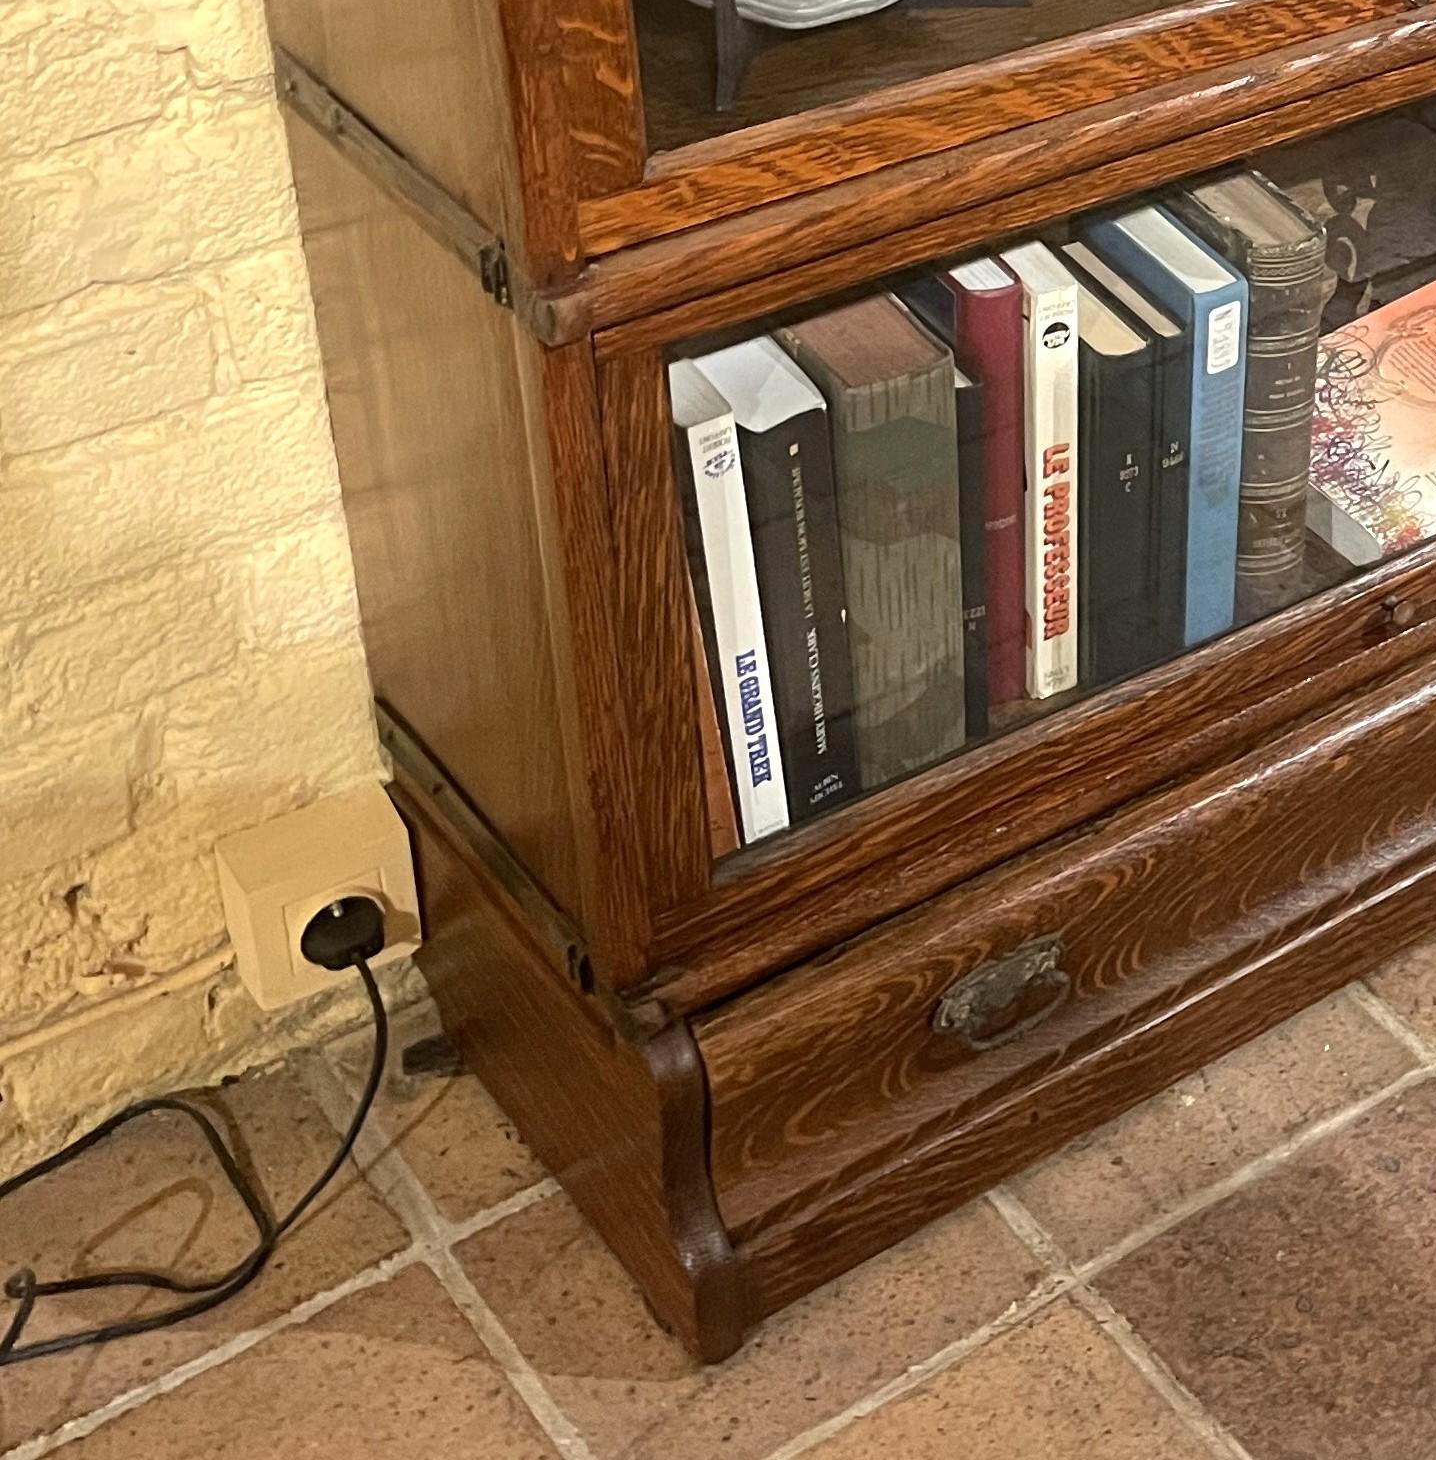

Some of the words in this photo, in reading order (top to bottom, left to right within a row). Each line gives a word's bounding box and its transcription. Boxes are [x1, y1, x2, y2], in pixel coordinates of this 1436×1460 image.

[1043, 444, 1070, 478] LE
[1043, 489, 1072, 642] PROFESSEUR
[736, 649, 755, 677] LE
[804, 624, 819, 670] CLARK
[739, 677, 766, 739] GRAND
[807, 670, 824, 721] HIGGINS
[812, 721, 827, 754] MARY
[809, 781, 844, 805] MICHEL
